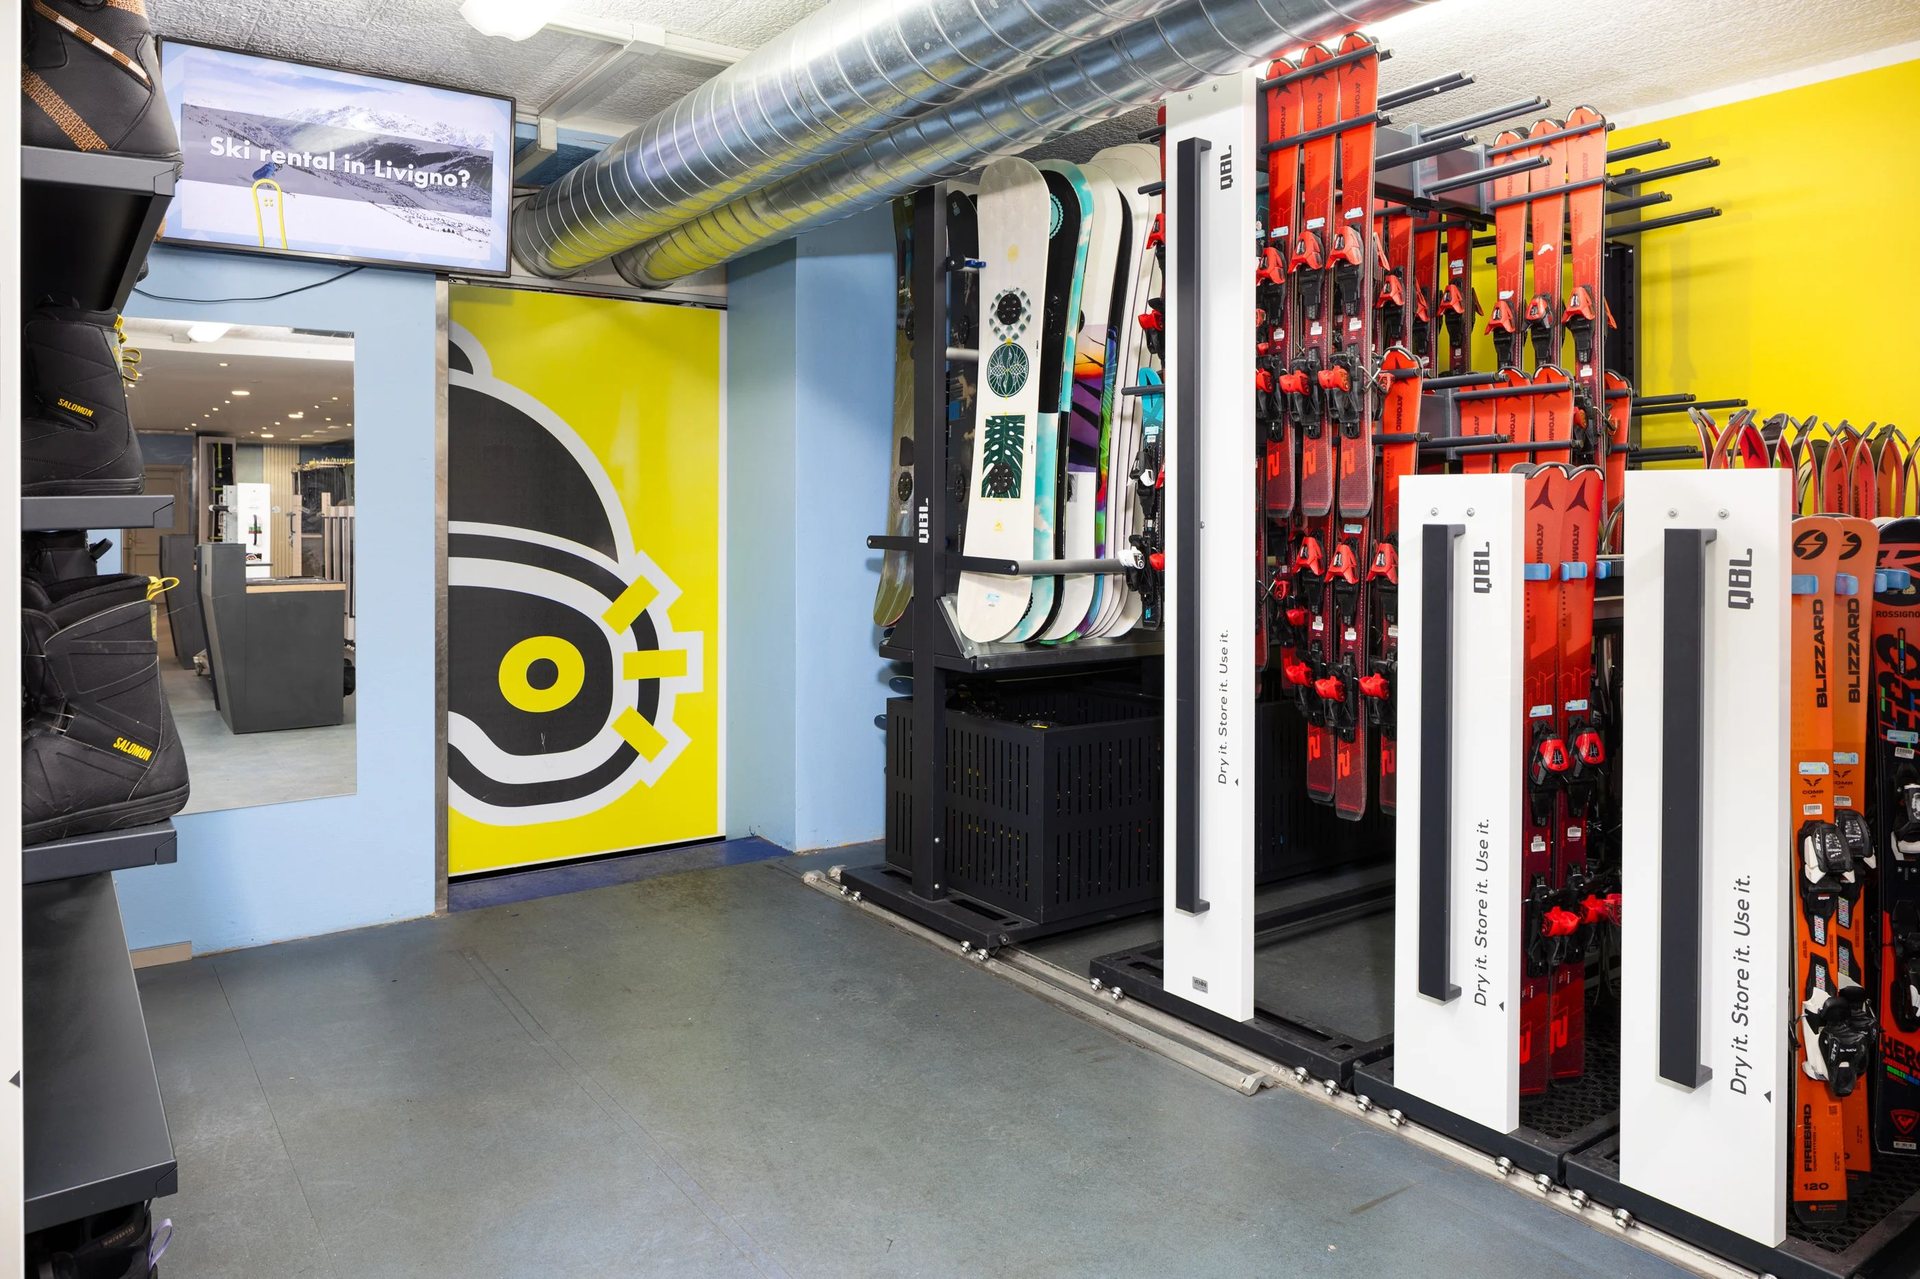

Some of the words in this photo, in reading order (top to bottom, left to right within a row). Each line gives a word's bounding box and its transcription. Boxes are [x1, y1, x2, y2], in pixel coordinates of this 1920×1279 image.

[210, 136, 250, 160] Ski
[259, 148, 335, 172] rental
[344, 154, 365, 175] in
[374, 159, 471, 189] Livigno?
[1220, 144, 1234, 191] QBL
[57, 398, 94, 417] SALOMON
[918, 497, 930, 544] QBL
[1572, 523, 1580, 562] ATOMI
[1473, 541, 1492, 594] QBL
[1728, 548, 1754, 610] QBL
[1219, 629, 1229, 643] it.
[1848, 598, 1861, 704] BLIZZARD
[1219, 646, 1229, 674] Use
[1813, 599, 1828, 708] BLIZZARD
[1219, 679, 1228, 693] it.
[1218, 696, 1228, 737] Store
[113, 736, 152, 761] SALOMON
[1218, 741, 1228, 755] it.
[1217, 757, 1230, 785] Dry
[1476, 819, 1490, 834] it.
[1475, 839, 1489, 873] Use
[1475, 879, 1488, 894] it.
[1733, 874, 1751, 893] it.
[1474, 899, 1488, 949] Store
[1733, 899, 1750, 936] Use
[1474, 954, 1488, 970] it.
[1733, 945, 1750, 963] it.
[1474, 973, 1490, 1006] Dry
[1731, 968, 1750, 1027] Store
[1731, 1034, 1748, 1052] it.
[1880, 1033, 1920, 1069] HER
[1730, 1056, 1752, 1095] Dry
[1804, 1104, 1812, 1172] FIREBIRD
[1804, 1182, 1829, 1191] 120
